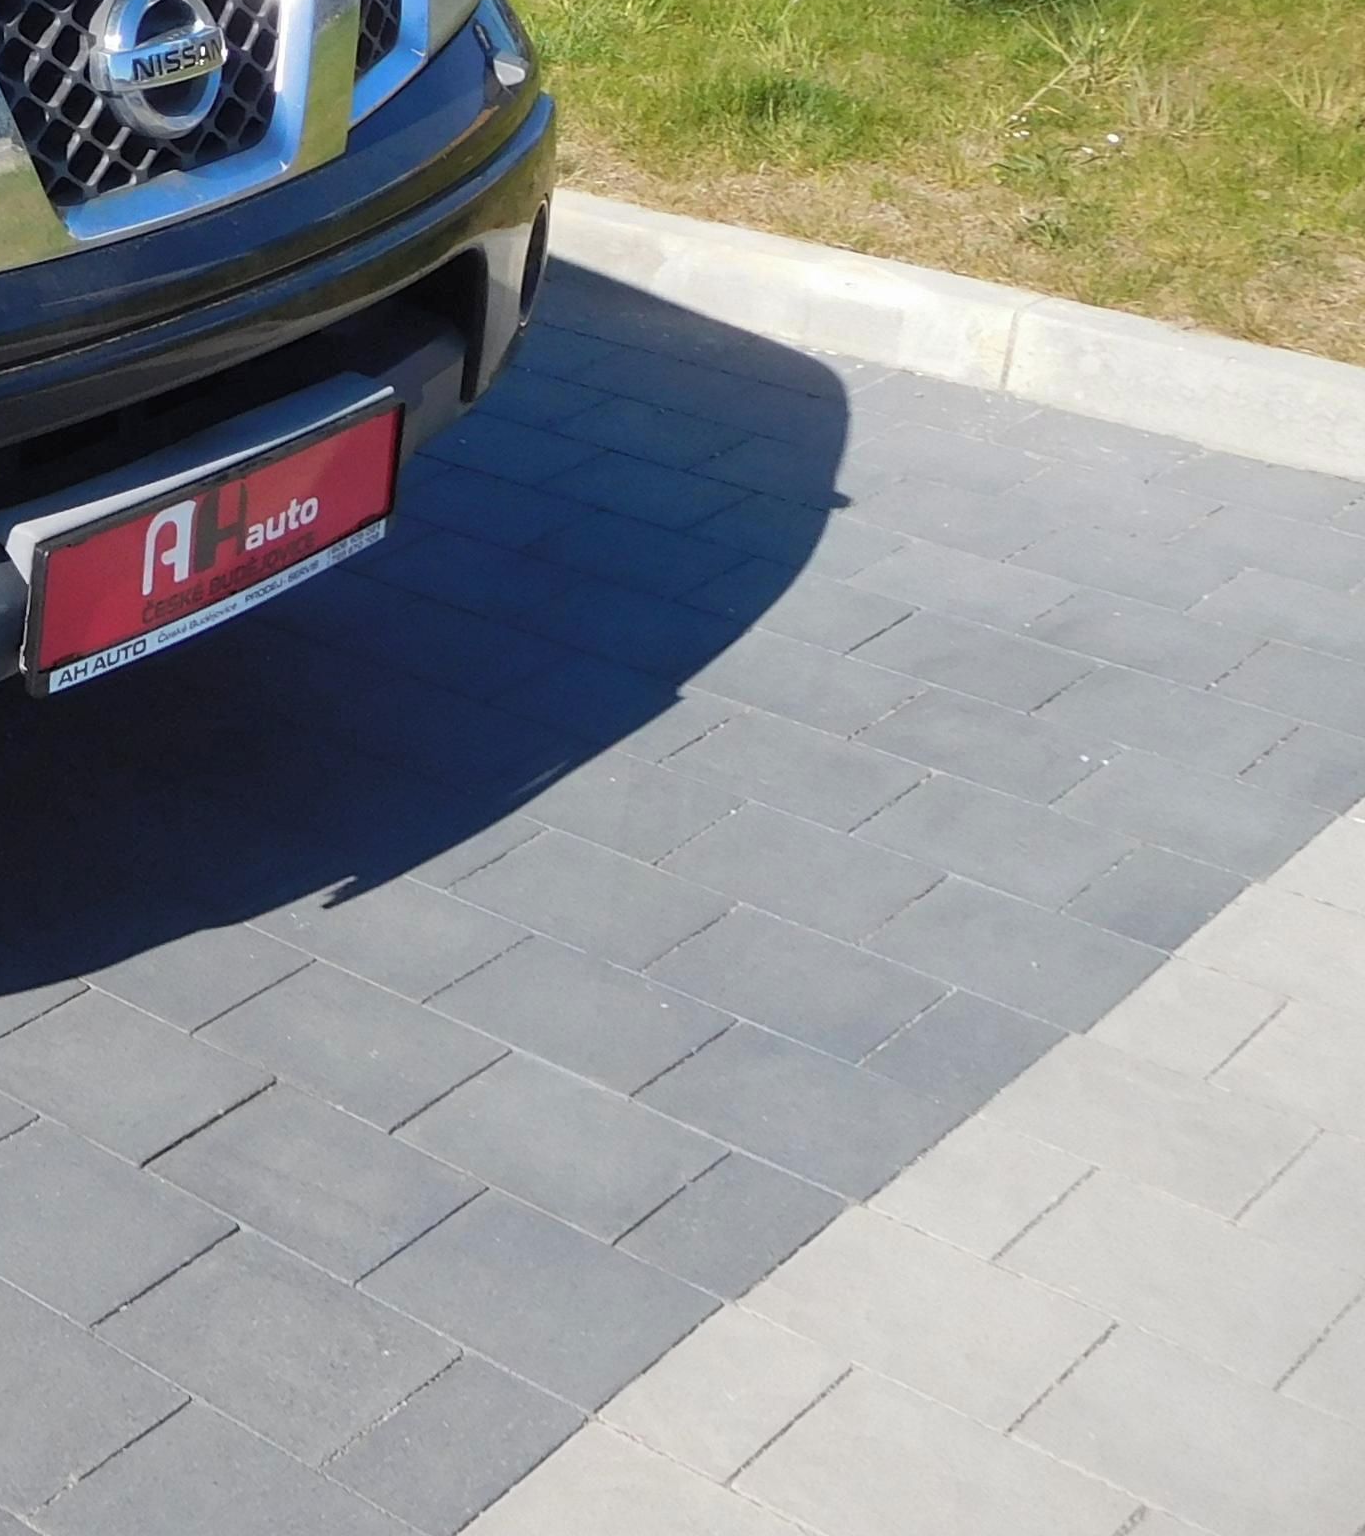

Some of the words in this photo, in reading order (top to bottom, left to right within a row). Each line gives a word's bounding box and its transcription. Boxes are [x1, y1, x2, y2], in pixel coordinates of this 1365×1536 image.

[132, 39, 221, 80] NISSAN
[245, 497, 318, 551] auto
[142, 582, 204, 625] ČESKÉ
[58, 663, 89, 687] AH
[92, 639, 147, 675] AUTO
